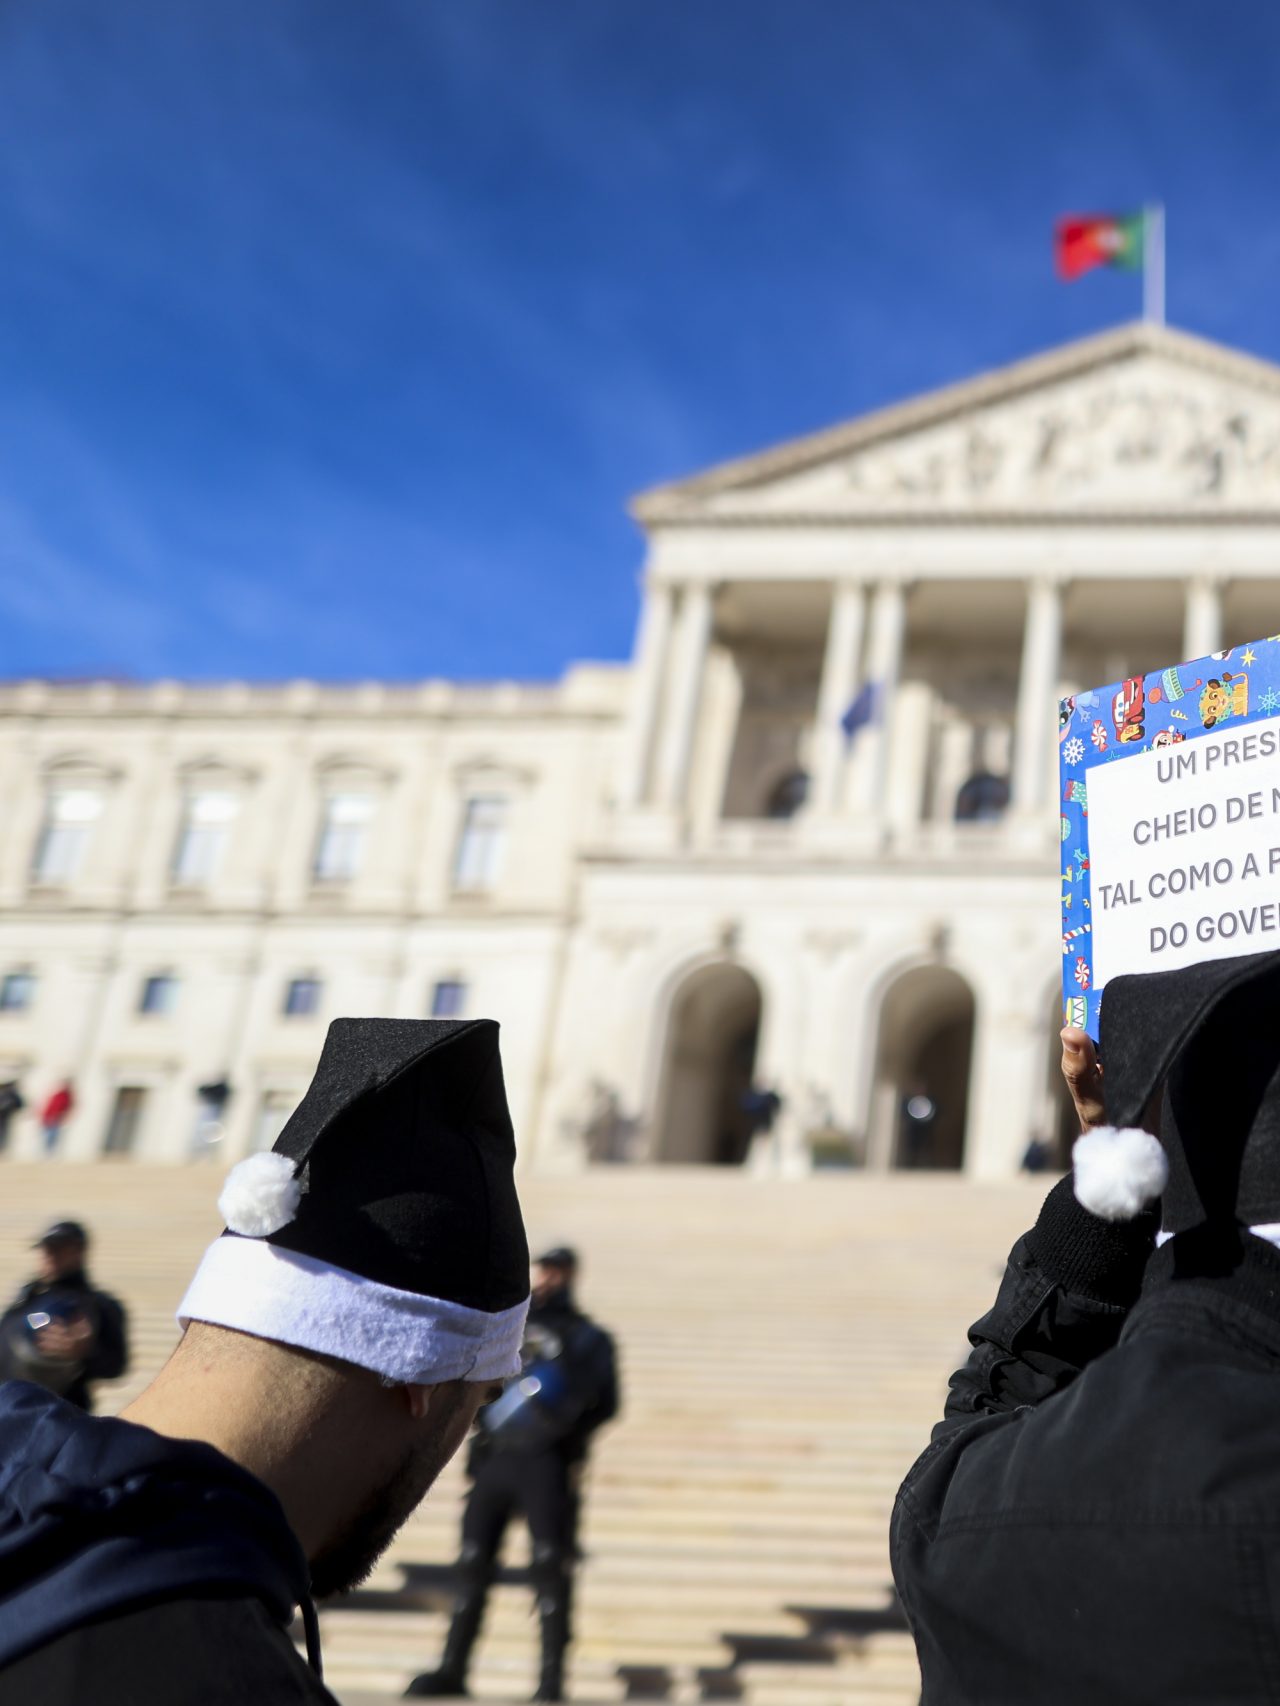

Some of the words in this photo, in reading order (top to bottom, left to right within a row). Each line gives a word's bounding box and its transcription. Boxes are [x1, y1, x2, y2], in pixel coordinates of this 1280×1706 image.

[1157, 750, 1197, 783] UM
[1133, 802, 1217, 845] CHEIO
[1226, 791, 1263, 824] DE
[1098, 879, 1142, 910] TAL
[1148, 857, 1233, 899] COMO
[1241, 852, 1260, 880] A
[1150, 921, 1188, 953] DO
